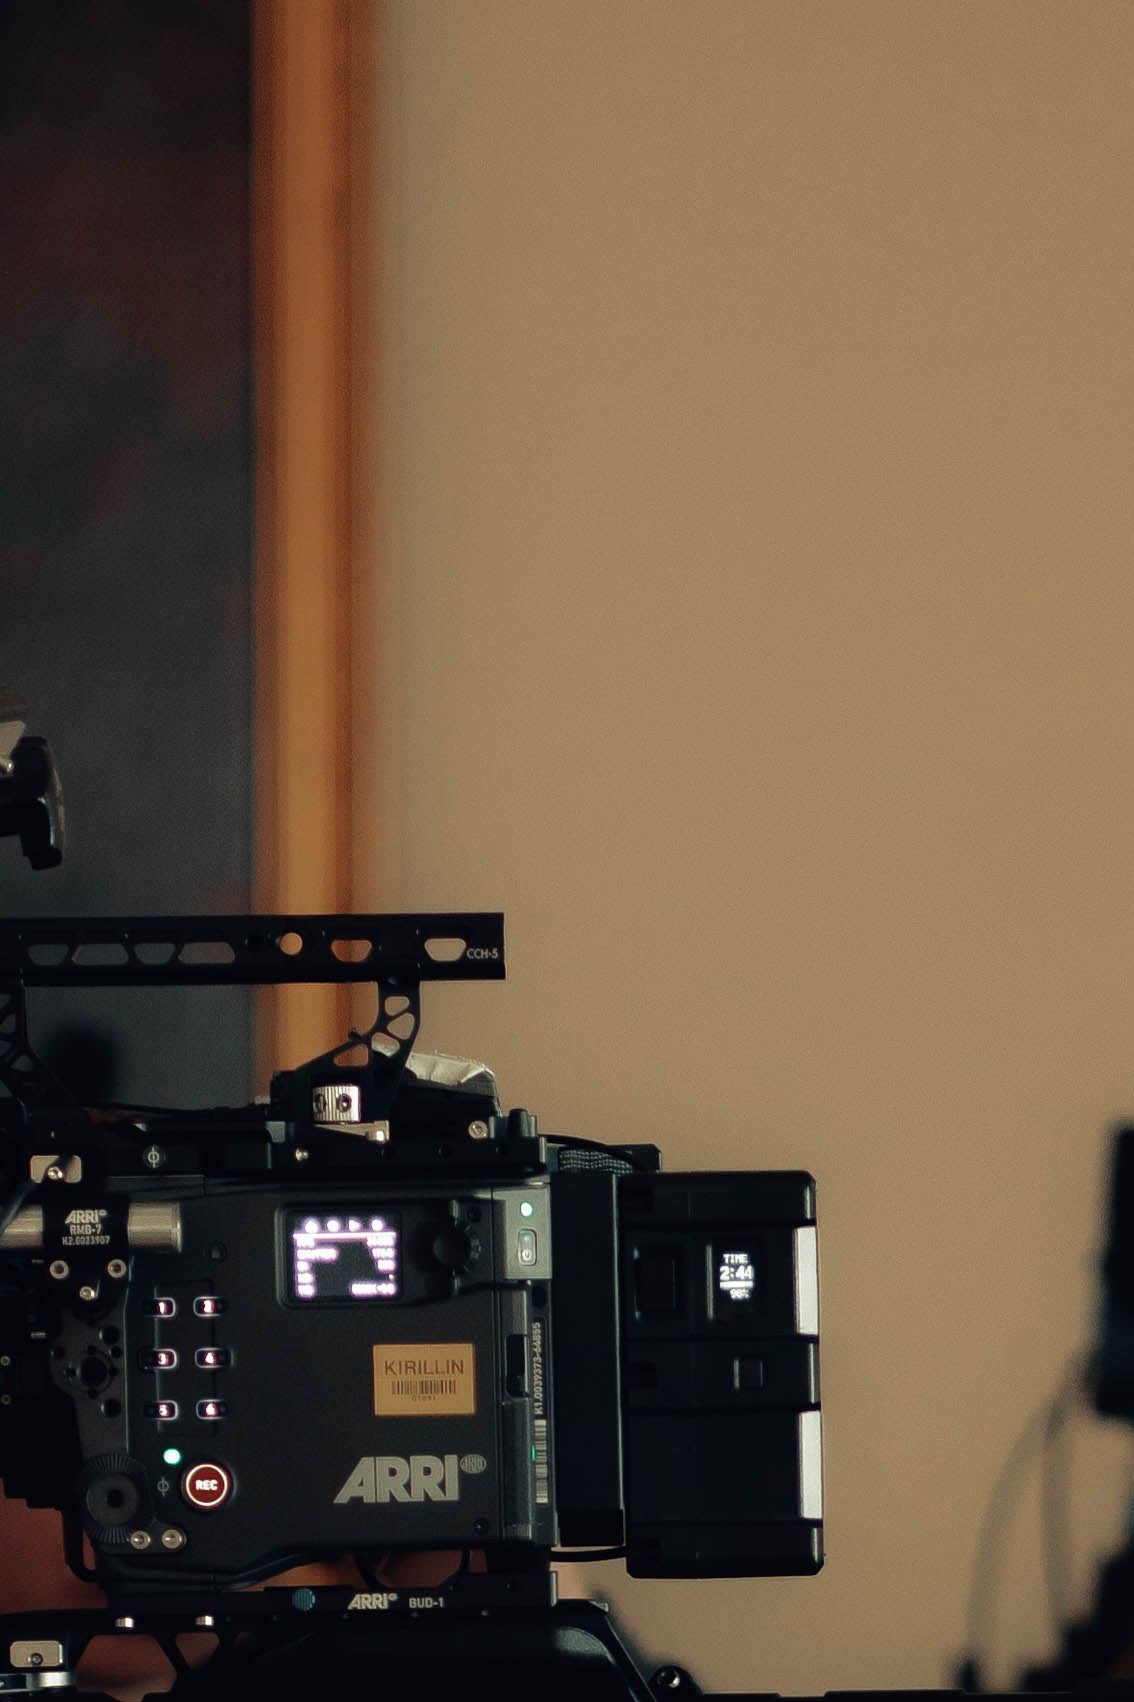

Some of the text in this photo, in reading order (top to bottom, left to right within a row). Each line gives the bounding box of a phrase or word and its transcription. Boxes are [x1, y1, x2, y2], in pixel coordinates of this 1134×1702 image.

[65, 1209, 99, 1225] ARRI
[70, 1224, 102, 1235] RMB-7
[723, 1253, 748, 1264] TIME
[720, 1265, 753, 1280] 2:44
[159, 1302, 166, 1314] 1
[159, 1353, 168, 1365] 3
[205, 1352, 214, 1364] 4
[384, 1360, 464, 1376] KIRILLIN
[159, 1405, 168, 1416] 5
[195, 1479, 218, 1491] REC
[333, 1454, 459, 1504] ARRI
[347, 1593, 444, 1610] ARRI BUD-1
